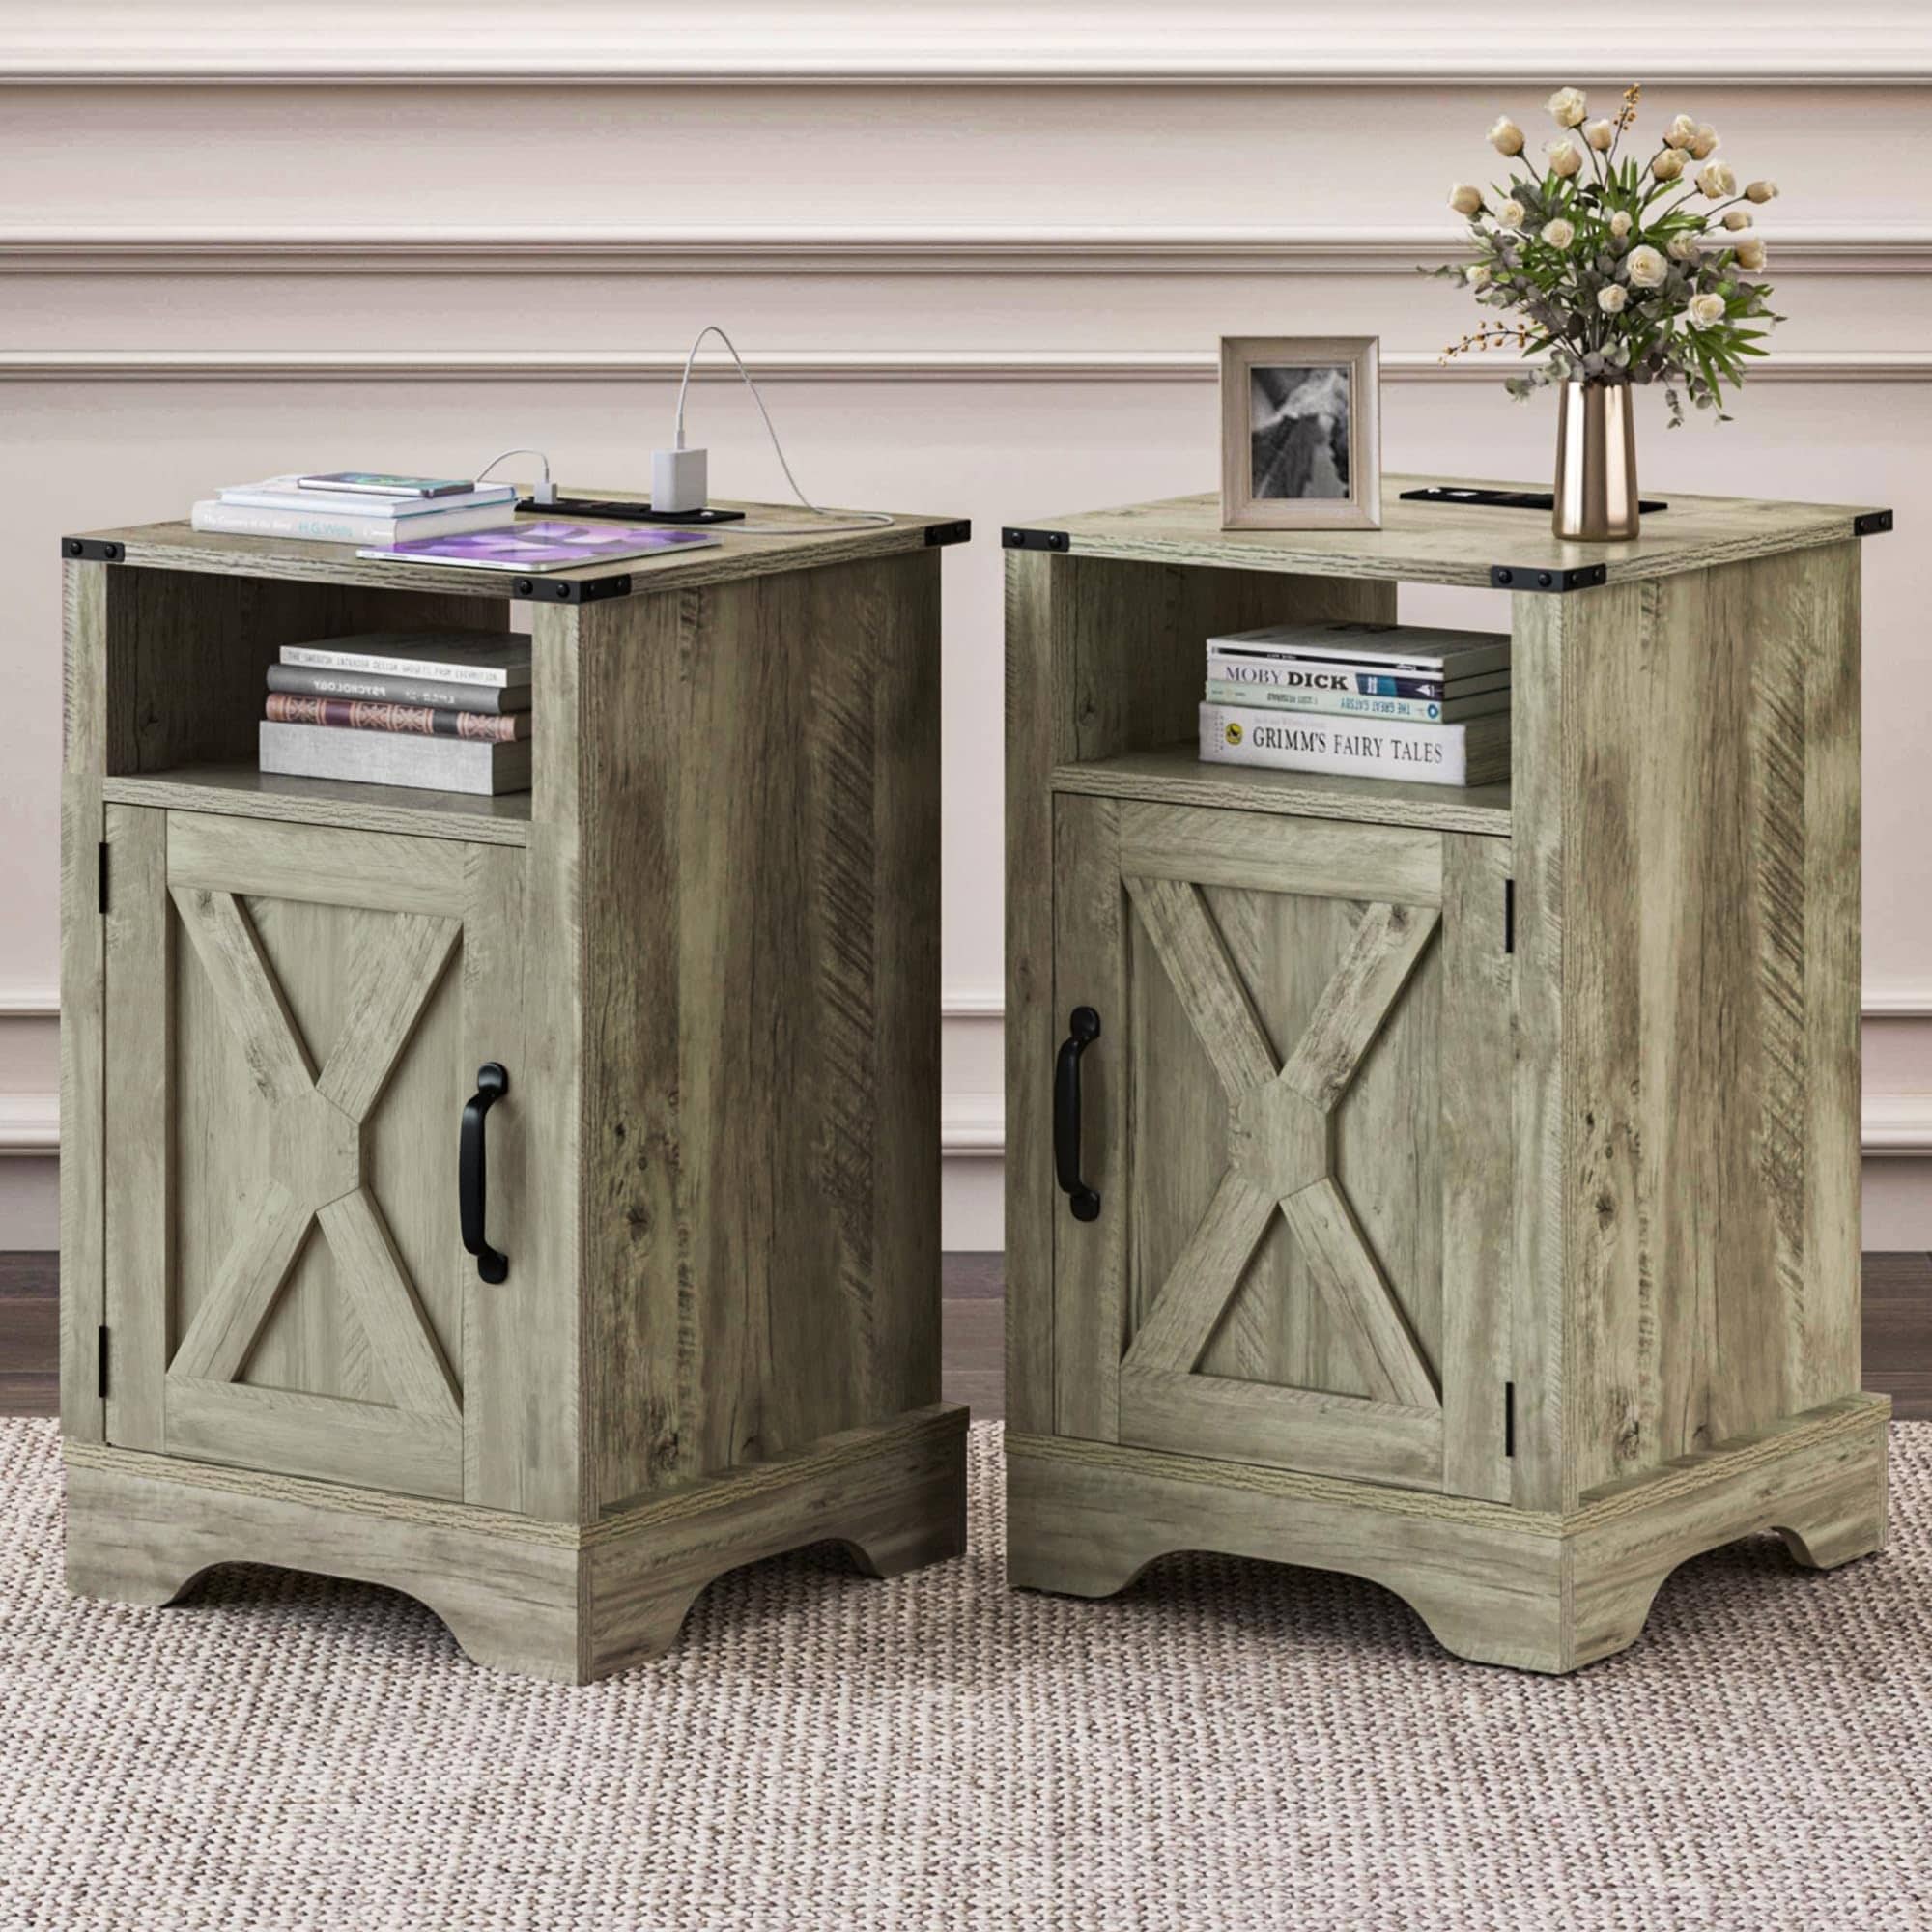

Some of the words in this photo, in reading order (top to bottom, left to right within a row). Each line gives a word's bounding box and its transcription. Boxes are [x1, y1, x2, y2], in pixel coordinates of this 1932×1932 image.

[1225, 666, 1282, 685] MOBY
[1287, 671, 1349, 691] DICK
[1340, 697, 1370, 712] GATSBY
[1371, 701, 1395, 714] GREAT
[1398, 703, 1411, 716] THE
[1252, 725, 1327, 754] GRIMM'S
[1333, 733, 1384, 758] FAIRY
[1391, 738, 1444, 764] TALES
